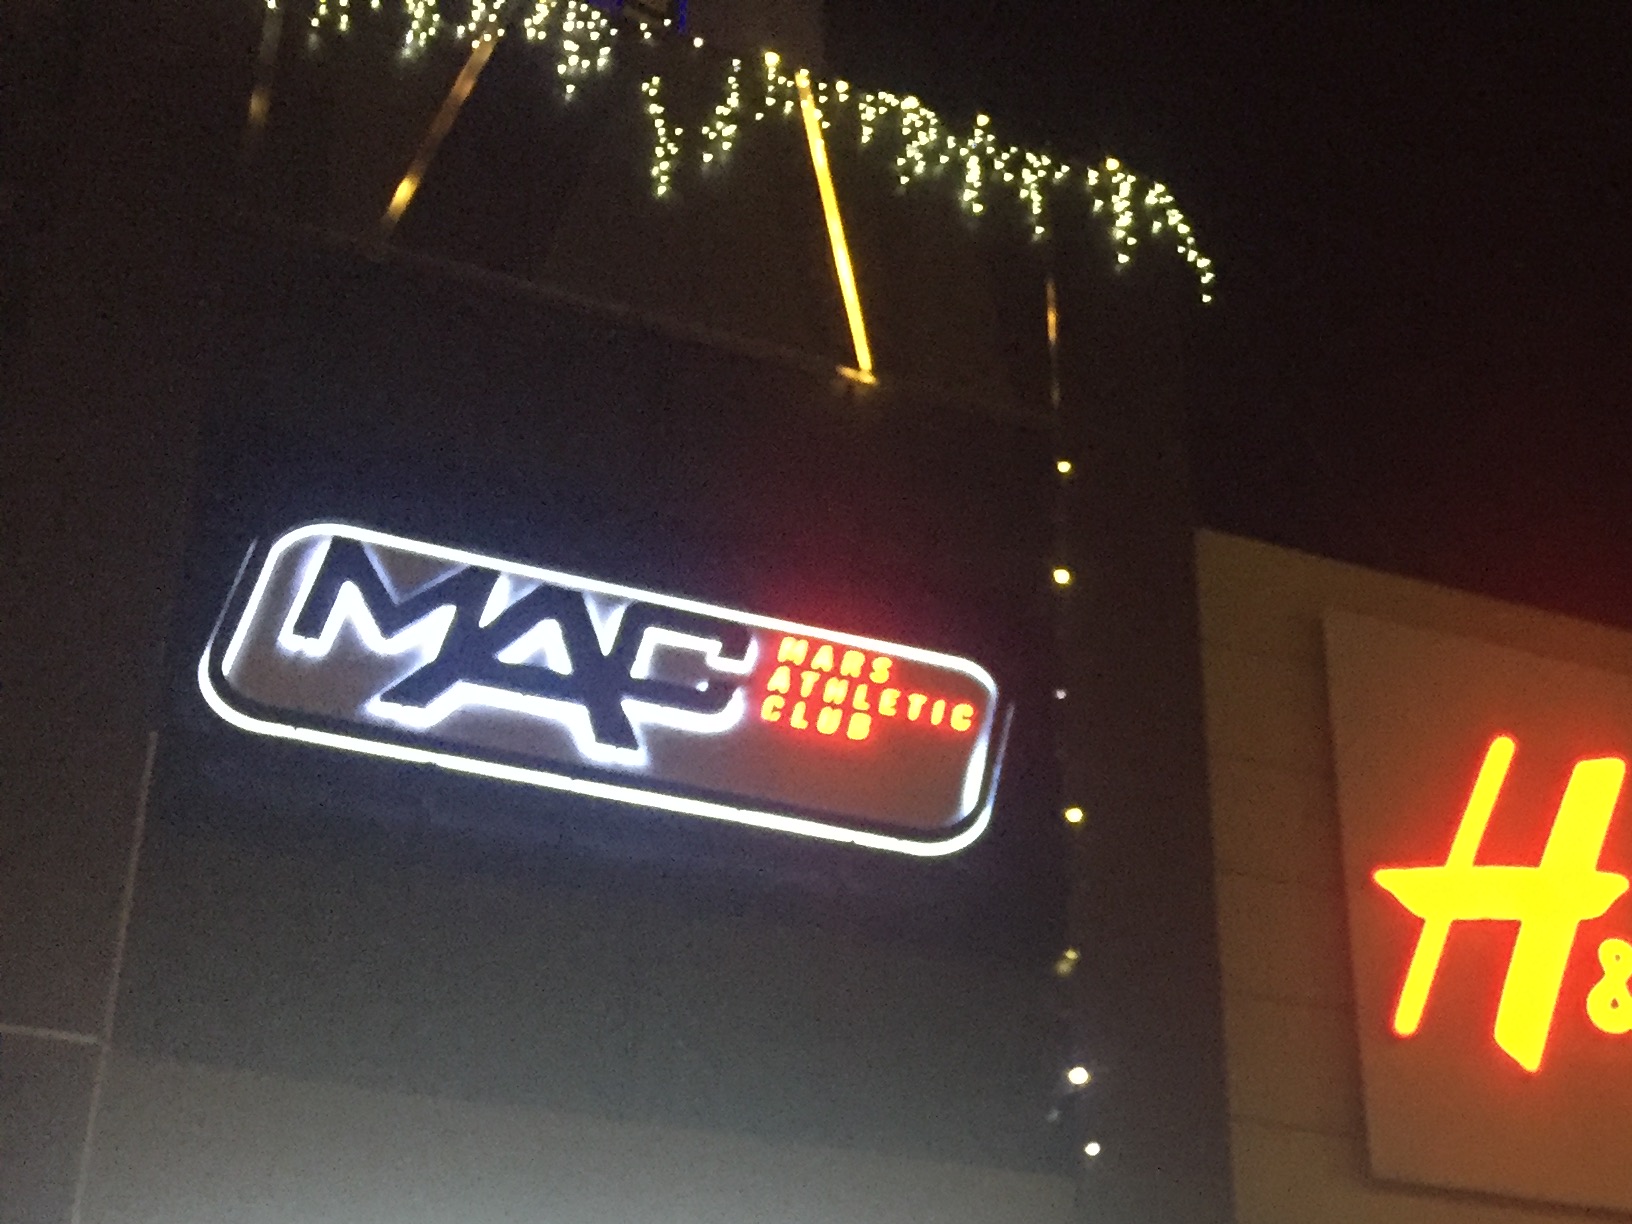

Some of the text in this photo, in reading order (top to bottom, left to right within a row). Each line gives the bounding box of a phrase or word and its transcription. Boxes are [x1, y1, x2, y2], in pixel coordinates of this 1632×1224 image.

[280, 534, 760, 767] MAC
[777, 636, 893, 684] MARS
[761, 694, 872, 741] CLUB
[767, 665, 975, 732] ATHLETIC
